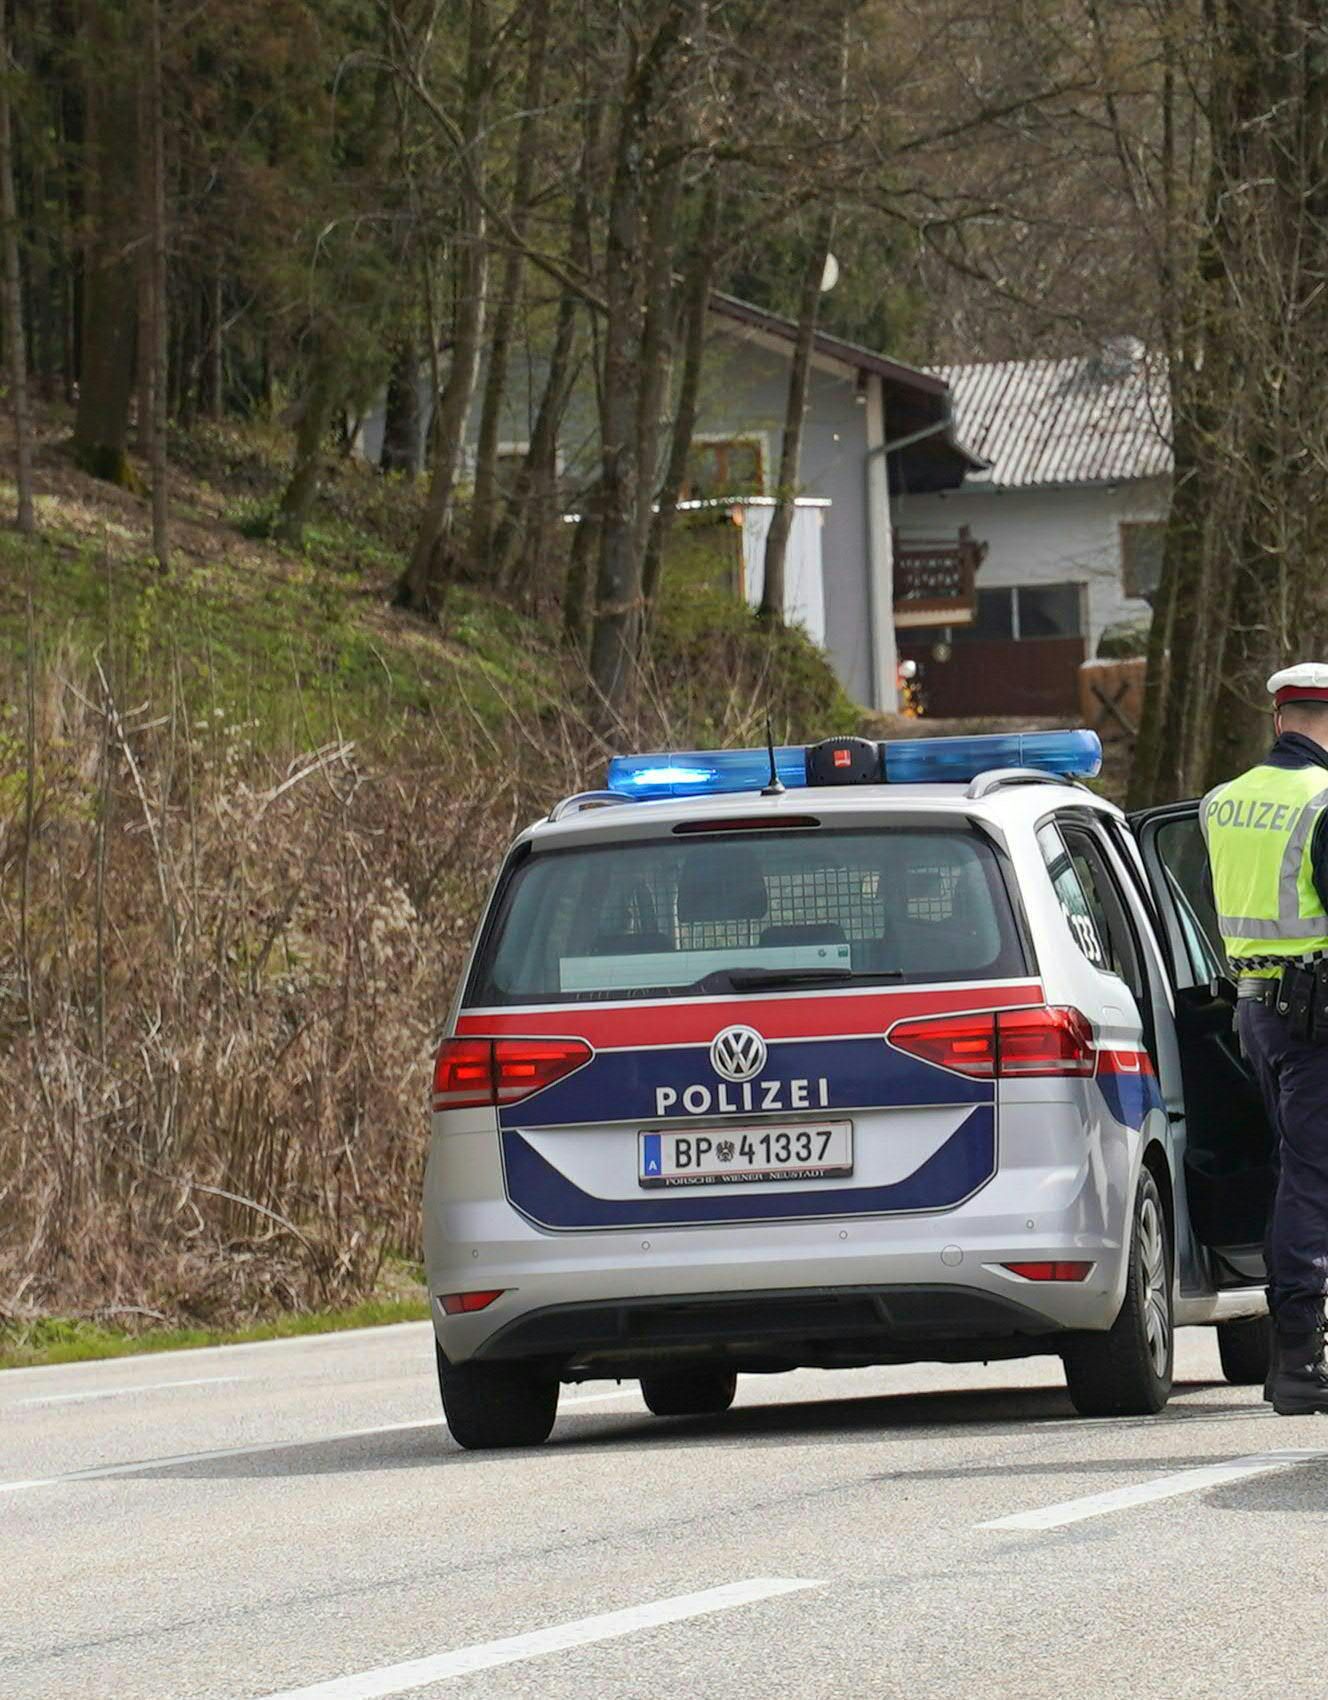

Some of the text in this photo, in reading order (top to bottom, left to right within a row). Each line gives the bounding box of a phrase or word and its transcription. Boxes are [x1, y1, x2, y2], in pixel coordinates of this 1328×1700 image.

[1208, 800, 1301, 831] POLIZEI
[656, 1078, 829, 1115] POLIZEI
[648, 1131, 832, 1170] A BP 41337
[665, 1169, 826, 1186] PORSCHE WIENER NEUSTADT
